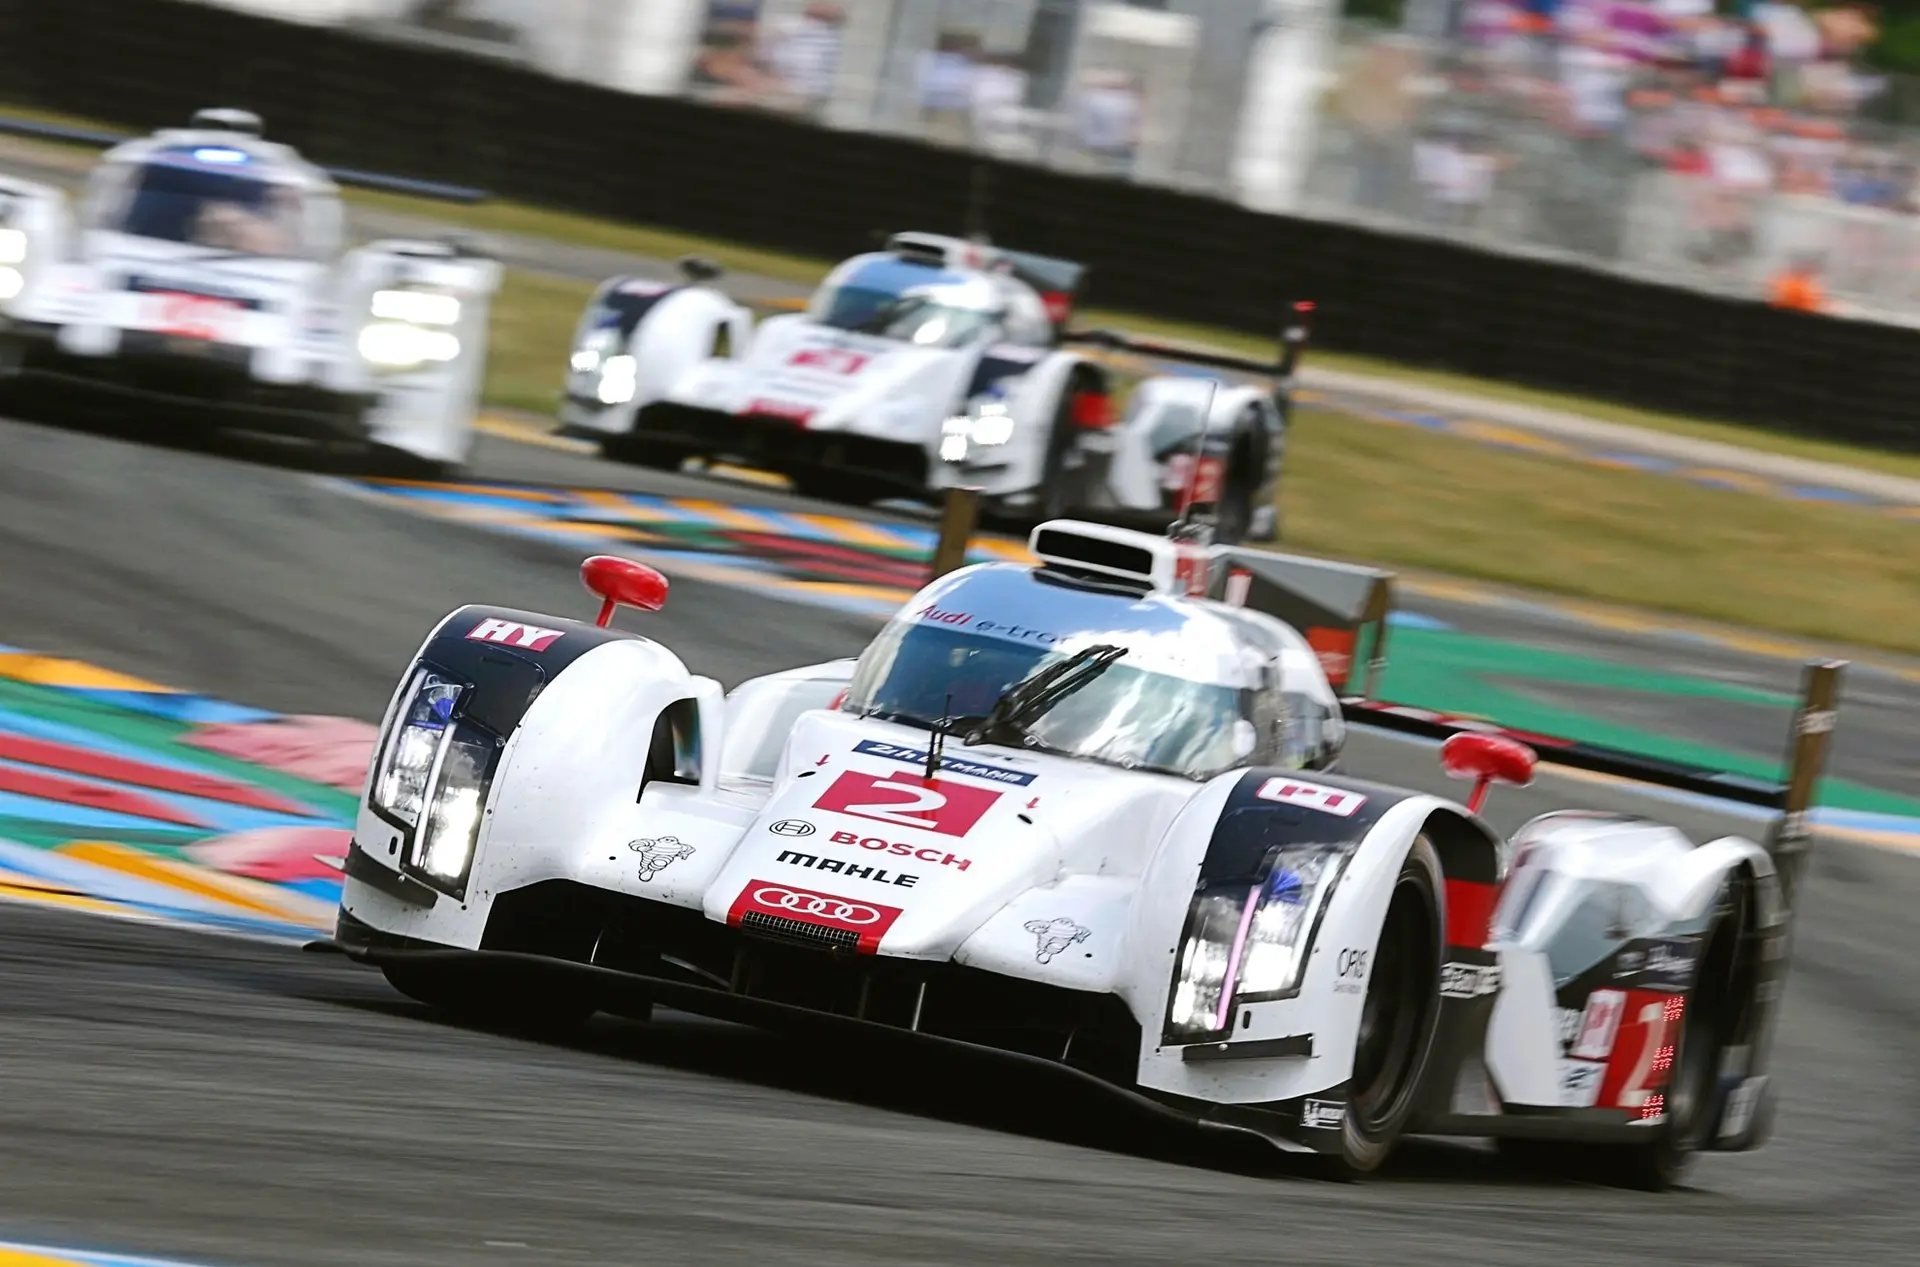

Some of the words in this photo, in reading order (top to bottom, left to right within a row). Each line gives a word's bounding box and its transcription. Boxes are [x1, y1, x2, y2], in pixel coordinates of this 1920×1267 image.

[468, 617, 566, 648] HY
[916, 604, 975, 626] Audi
[844, 780, 948, 830] 2
[776, 850, 920, 888] MAHLE
[829, 831, 972, 872] BOSCH
